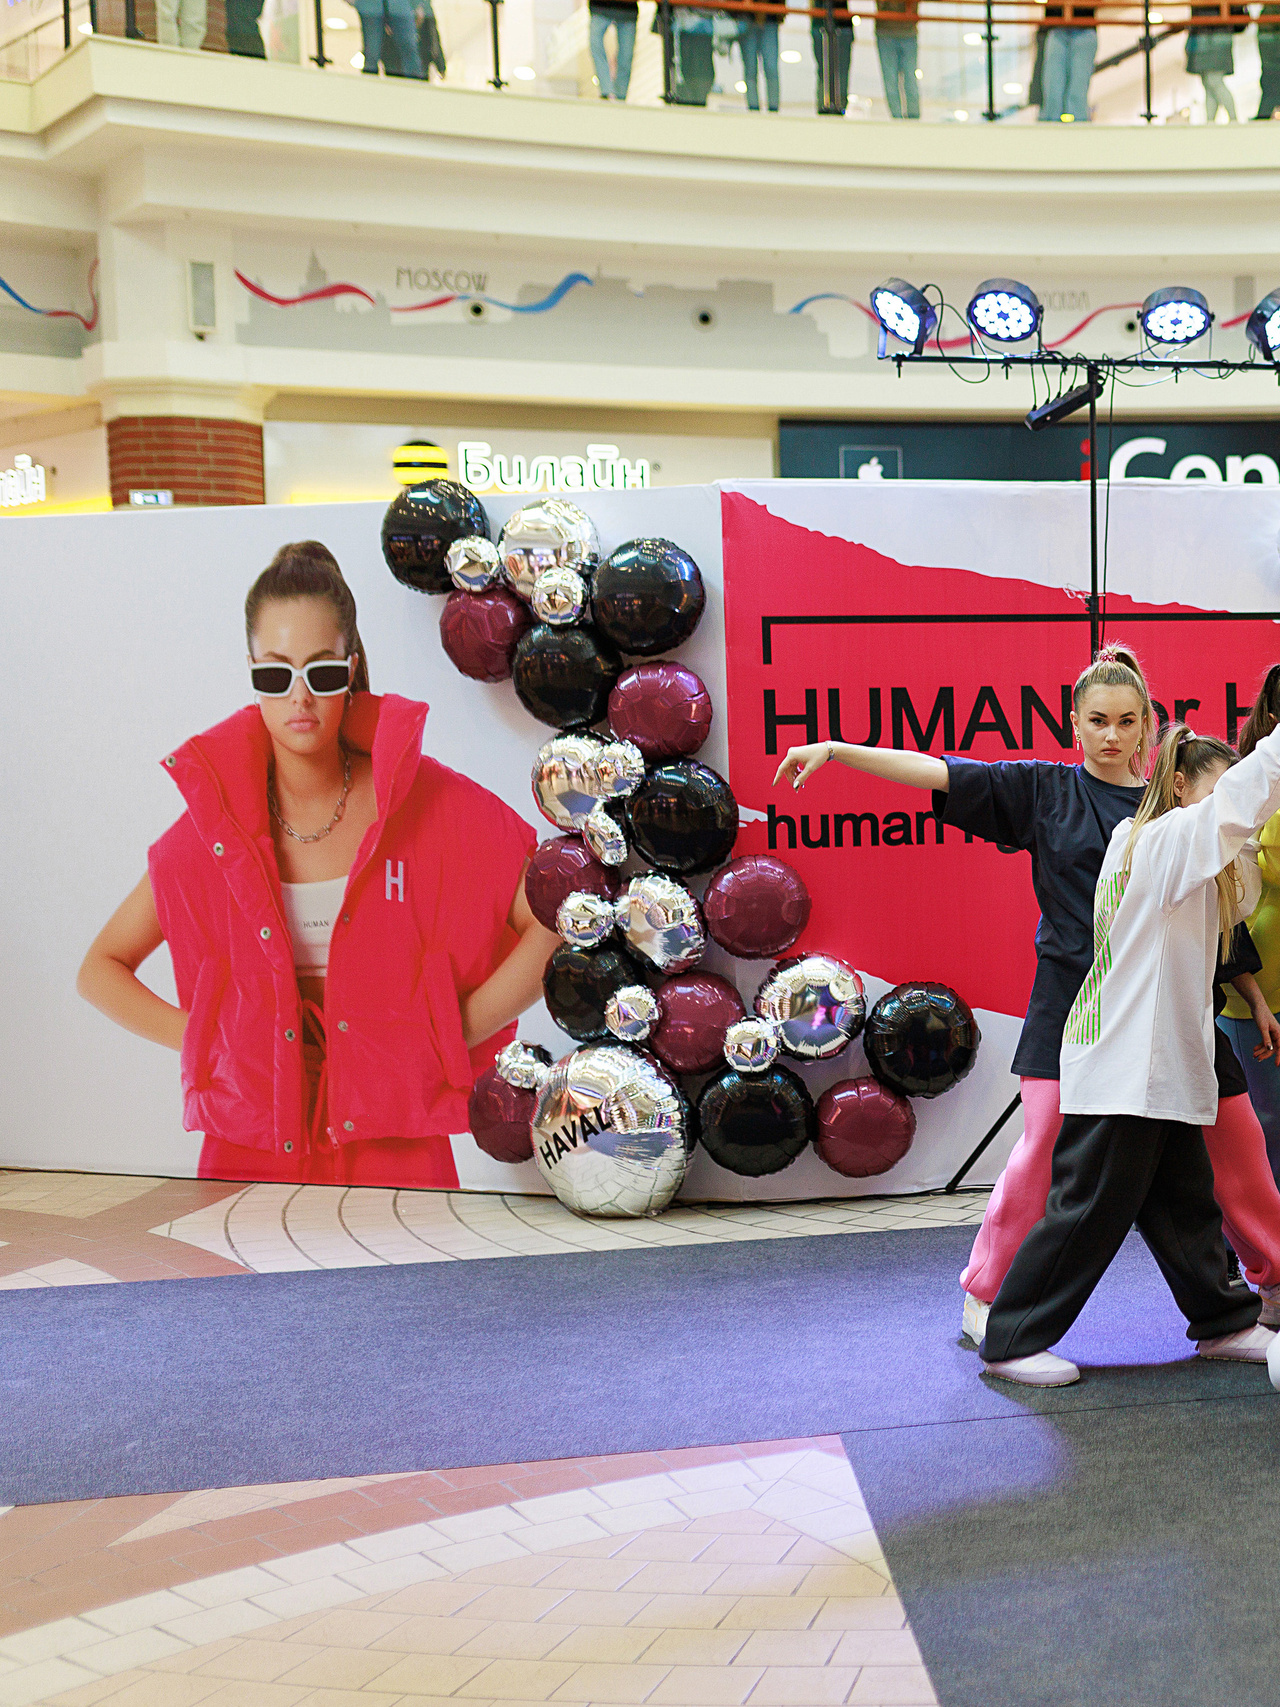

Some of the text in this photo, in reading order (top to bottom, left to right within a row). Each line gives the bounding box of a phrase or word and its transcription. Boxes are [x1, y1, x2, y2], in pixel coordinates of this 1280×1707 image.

[396, 266, 488, 292] MOSCOW
[457, 441, 650, 492] Билайн
[763, 685, 1073, 755] HUMAN
[767, 804, 945, 850] human
[386, 859, 404, 903] H
[540, 1106, 612, 1170] HAVAL
